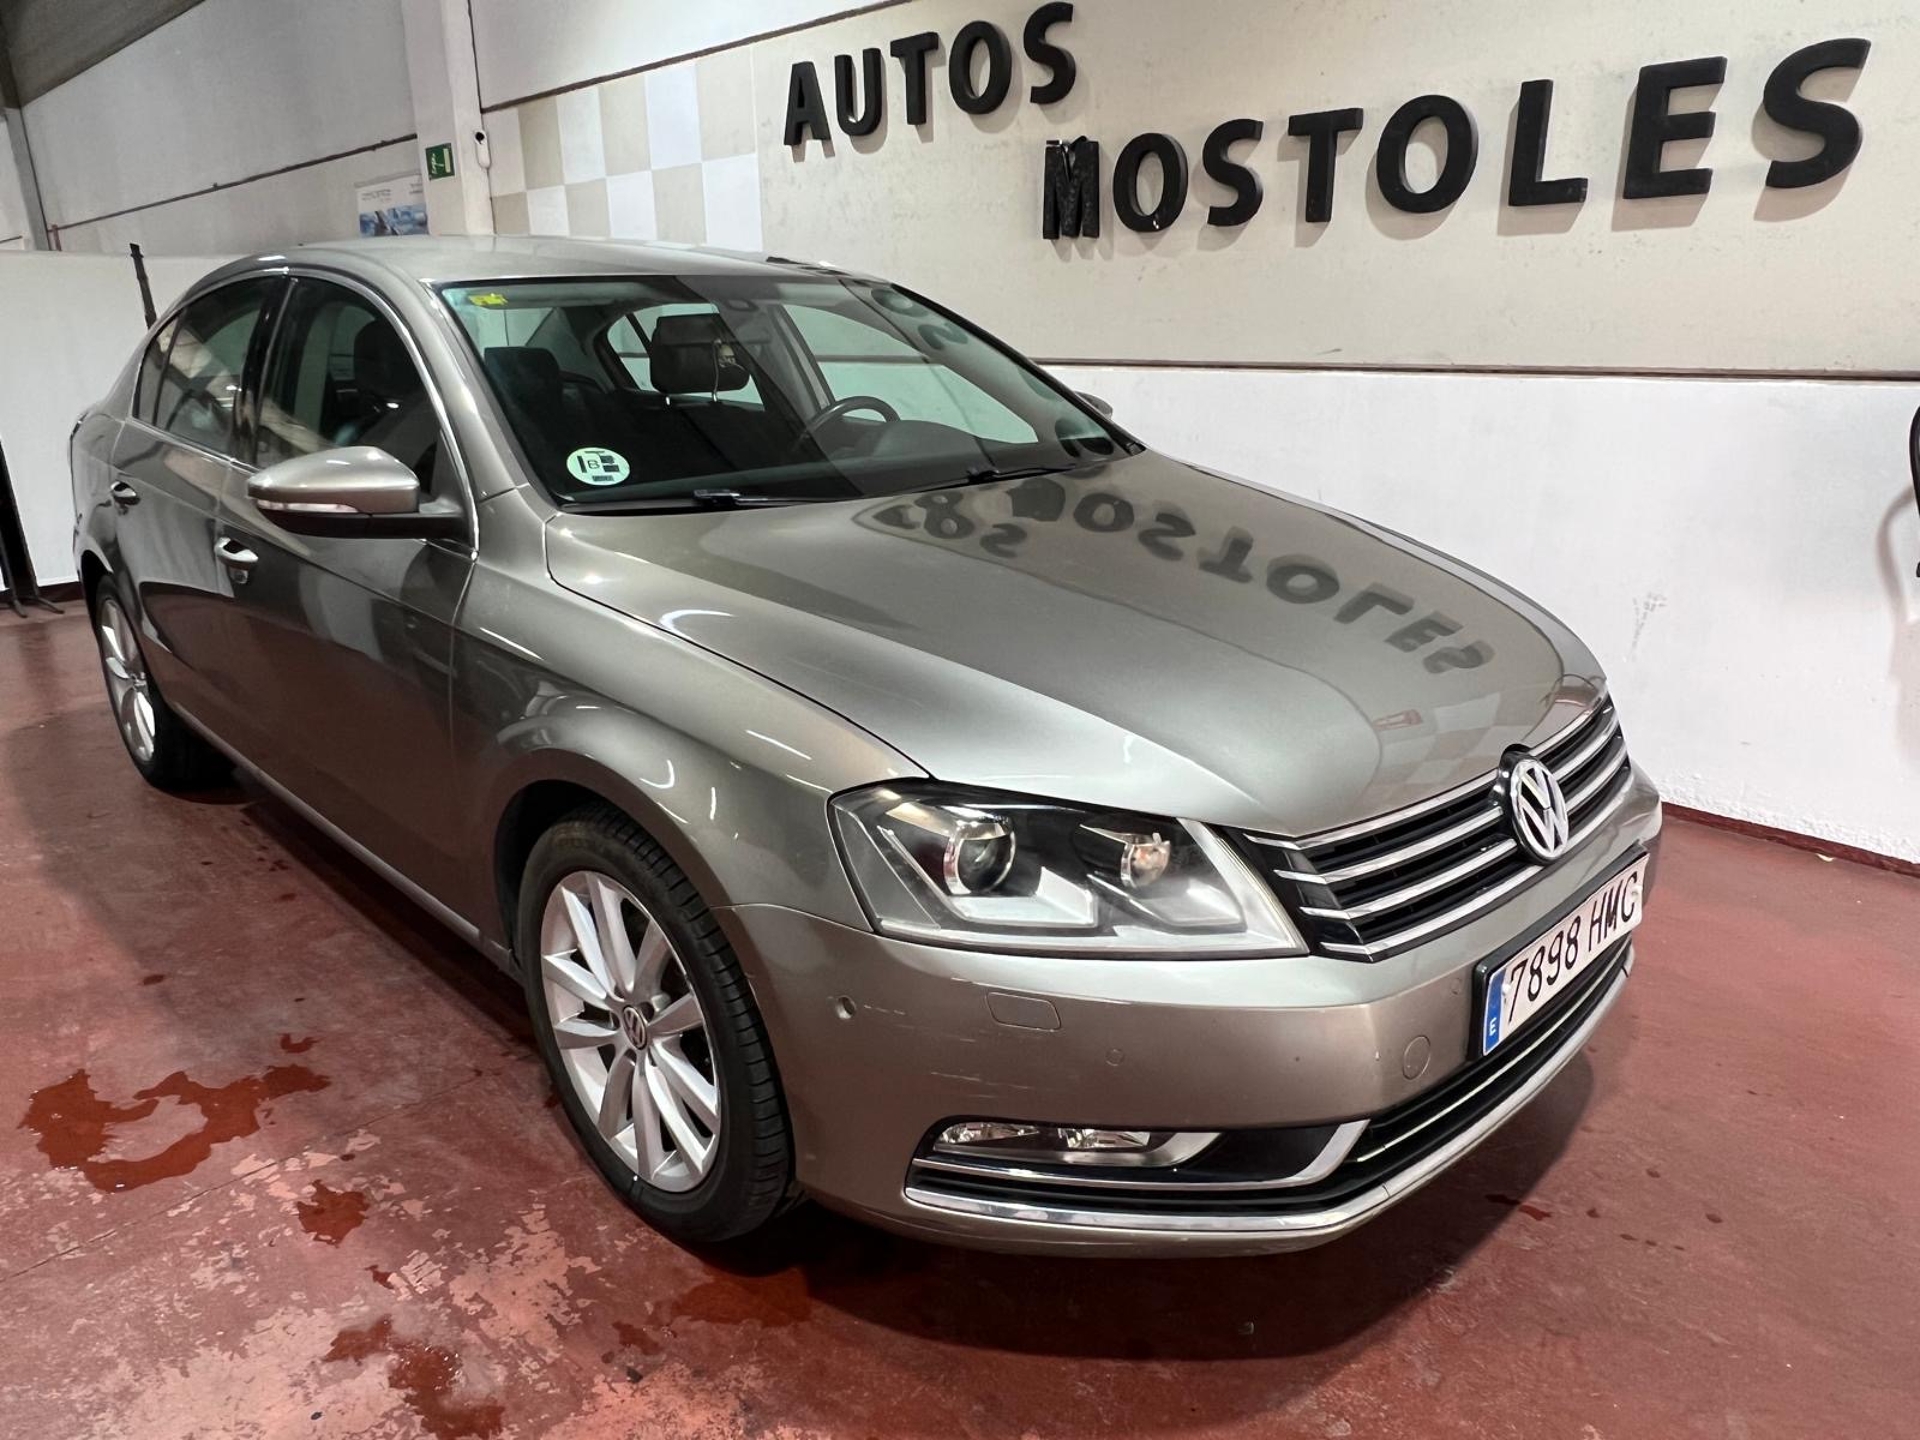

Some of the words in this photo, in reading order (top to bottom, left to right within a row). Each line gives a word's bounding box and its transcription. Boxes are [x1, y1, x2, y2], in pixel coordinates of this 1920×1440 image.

[783, 1, 1076, 146] AUTOS
[1043, 37, 1871, 240] MOSTOLES
[1509, 915, 1580, 1022] 7898
